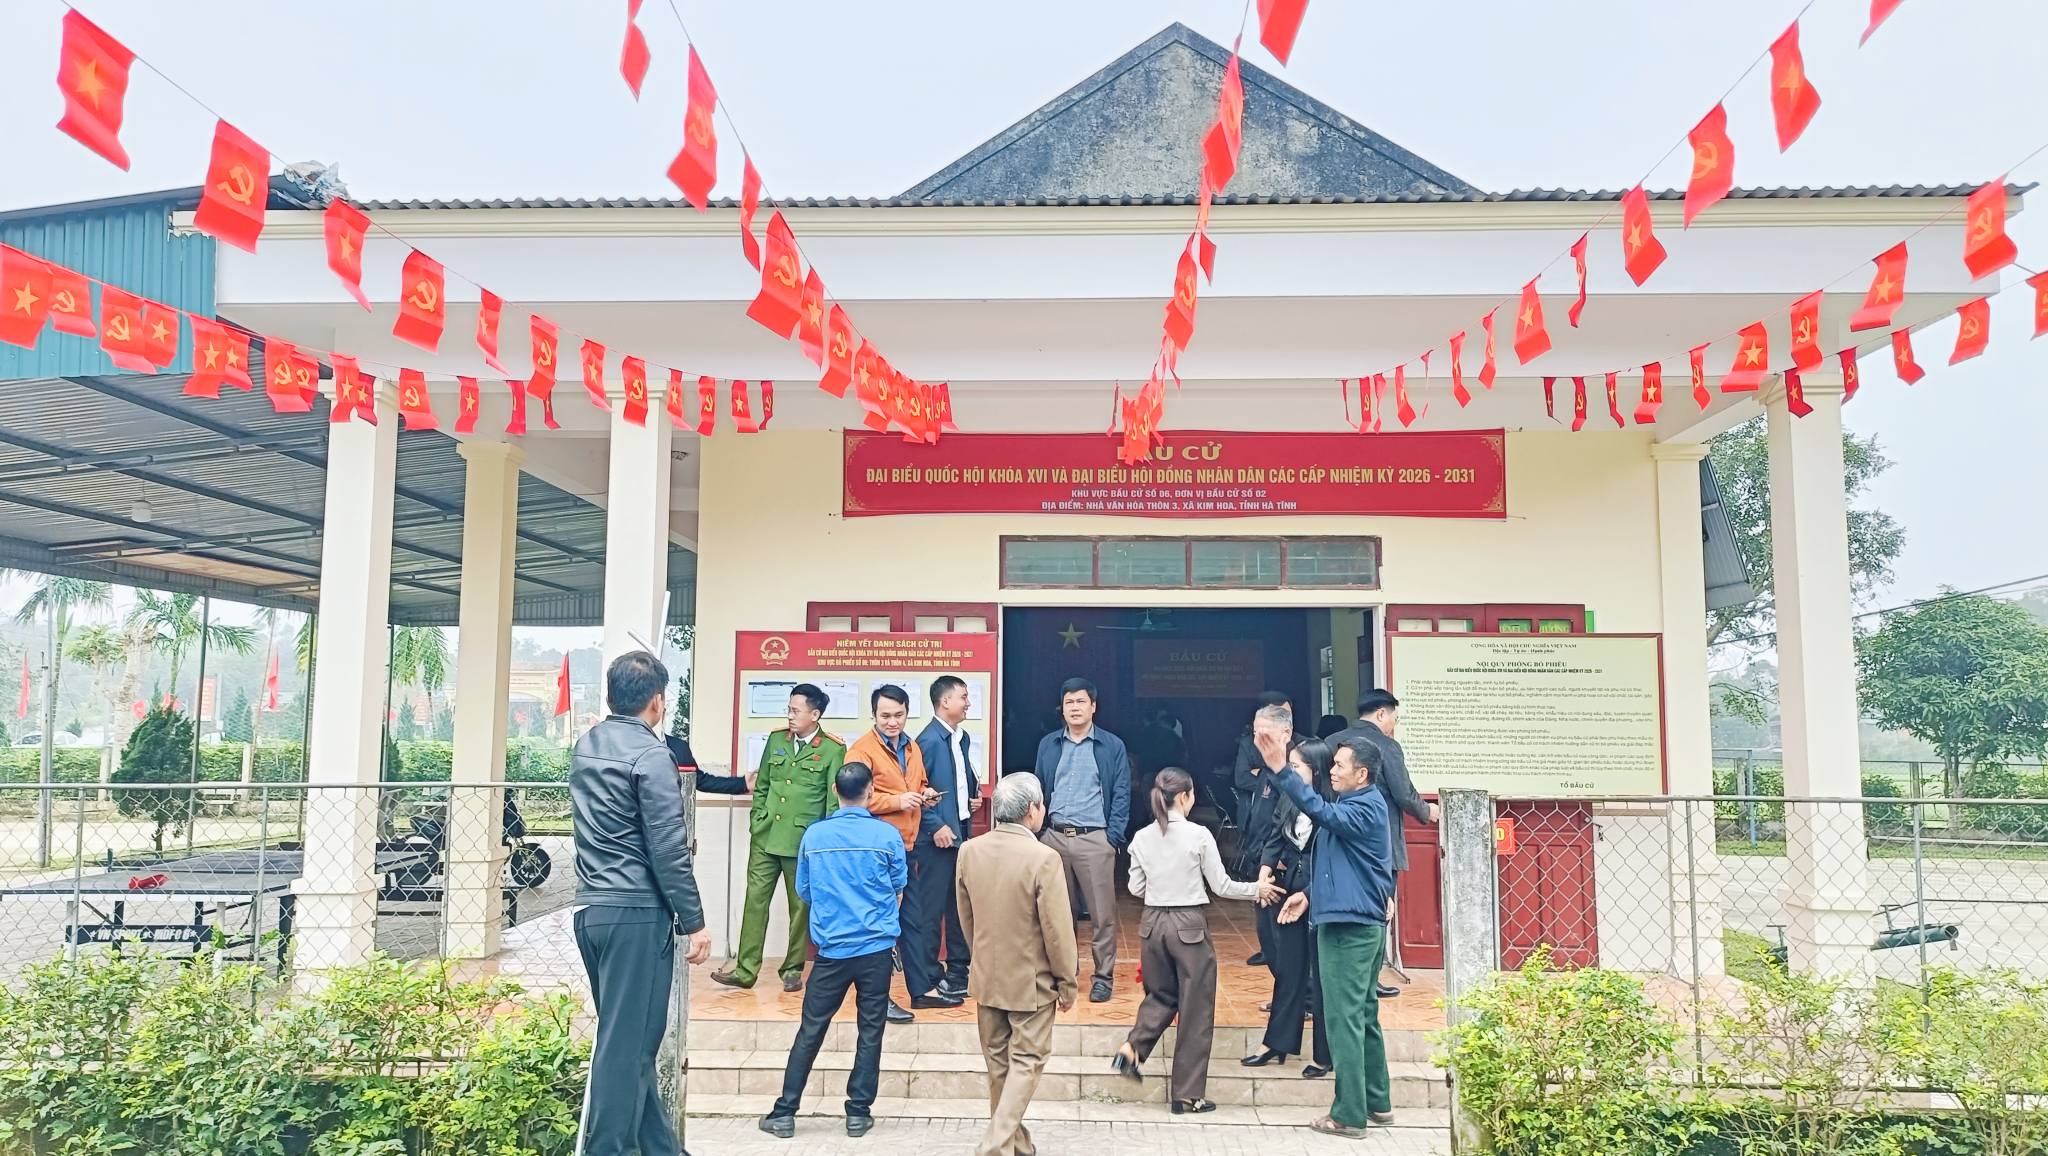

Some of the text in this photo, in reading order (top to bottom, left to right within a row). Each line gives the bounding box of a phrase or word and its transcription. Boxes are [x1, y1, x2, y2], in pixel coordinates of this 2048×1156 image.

[1182, 441, 1223, 461] CỬ
[866, 468, 888, 486] ĐẠI
[892, 462, 921, 484] BIỂU
[925, 463, 959, 485] QUỐC
[963, 467, 986, 487] HỘI
[989, 465, 1024, 484] KHÓA
[1027, 468, 1048, 484] XVI
[1052, 465, 1068, 484] VÀ
[1072, 468, 1094, 487] ĐẠI
[1098, 463, 1127, 484] BIỂU
[1131, 467, 1152, 487] HỘI
[1156, 463, 1193, 484] ĐỒNG
[1196, 466, 1233, 484] NHÂN
[1237, 466, 1265, 484] DÂN
[1269, 466, 1295, 484] CÁC
[1299, 463, 1326, 484] CẤP
[1330, 466, 1374, 486] NHIỆM
[1377, 465, 1394, 484] KỲ
[1398, 468, 1431, 484] 2026
[1444, 468, 1475, 484] 2031
[1256, 490, 1267, 498] 02
[836, 638, 942, 648] NIÊM YẾT DANH SÁCH CỬ TRI
